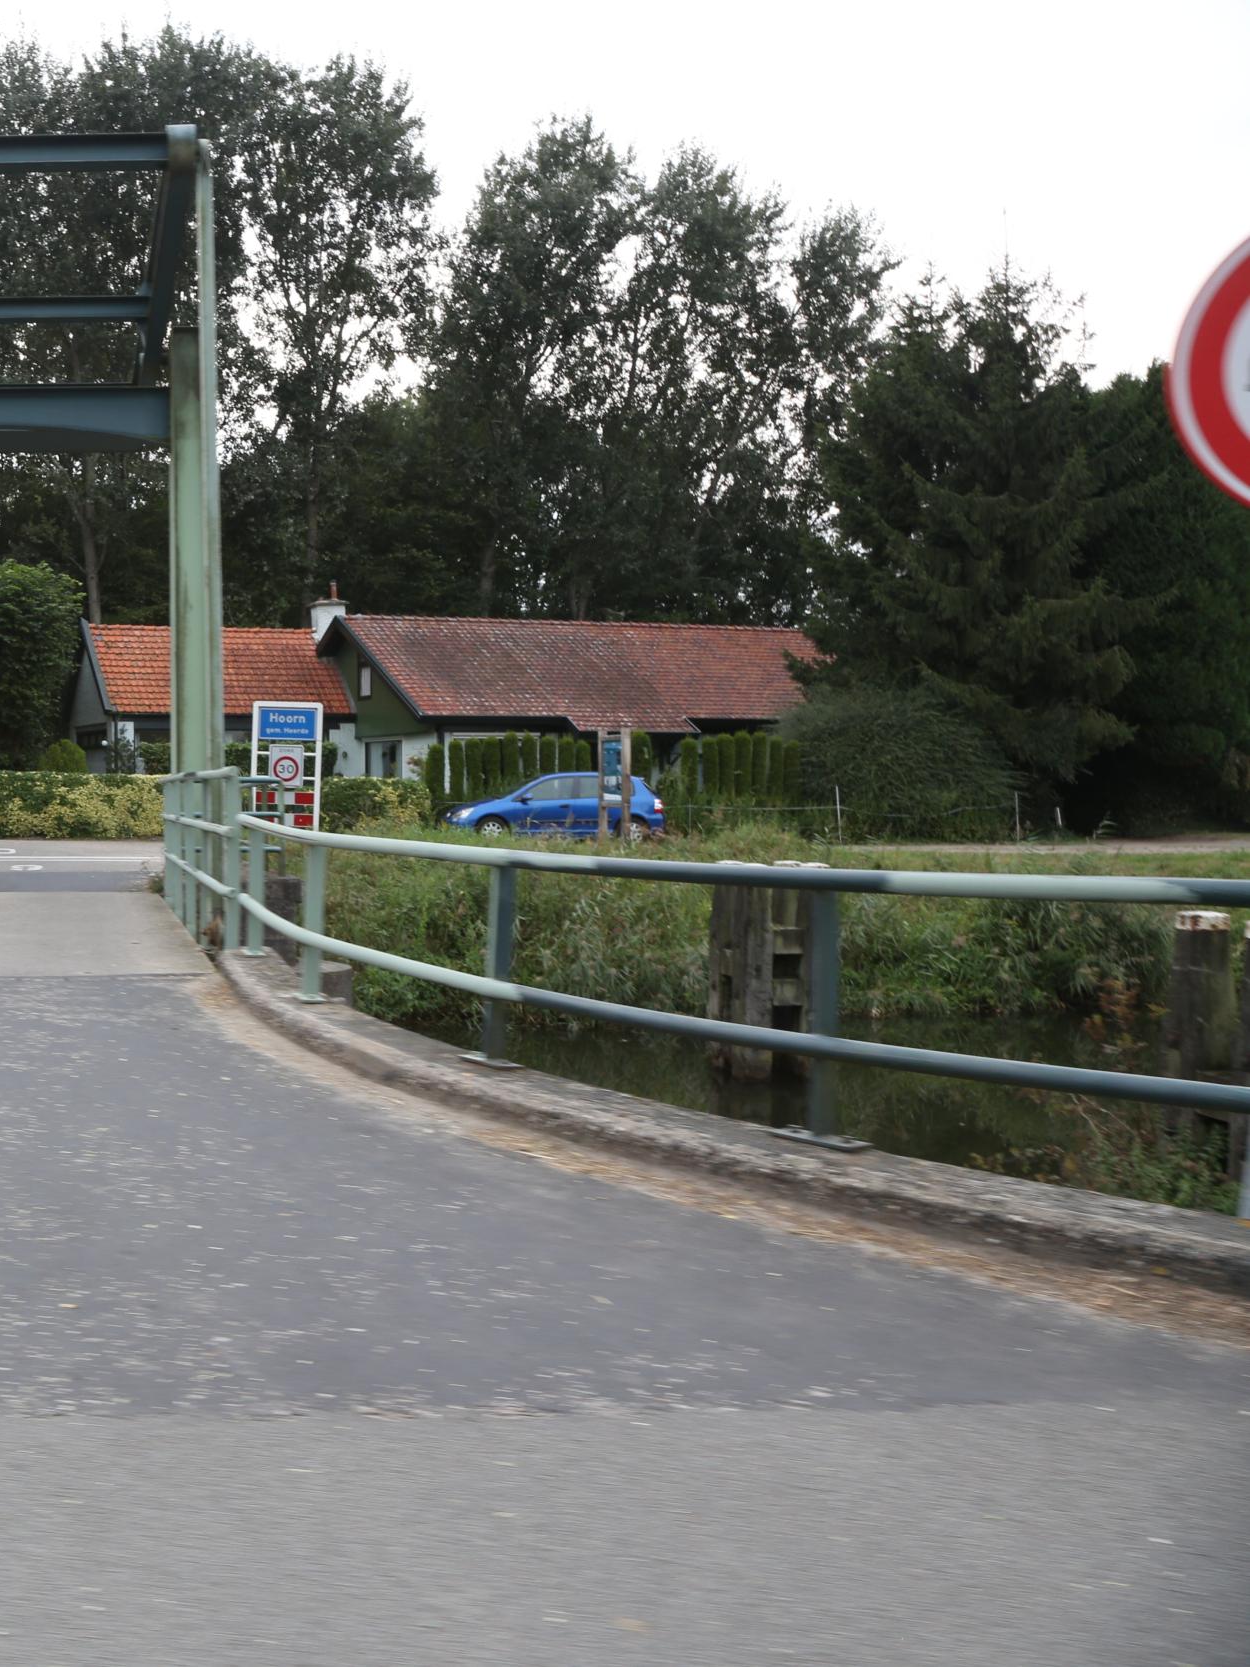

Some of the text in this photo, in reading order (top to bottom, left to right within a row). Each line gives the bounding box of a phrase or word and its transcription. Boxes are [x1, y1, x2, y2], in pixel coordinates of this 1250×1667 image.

[269, 712, 306, 723] Hoorn
[266, 727, 283, 735] gem.
[278, 764, 294, 774] 30
